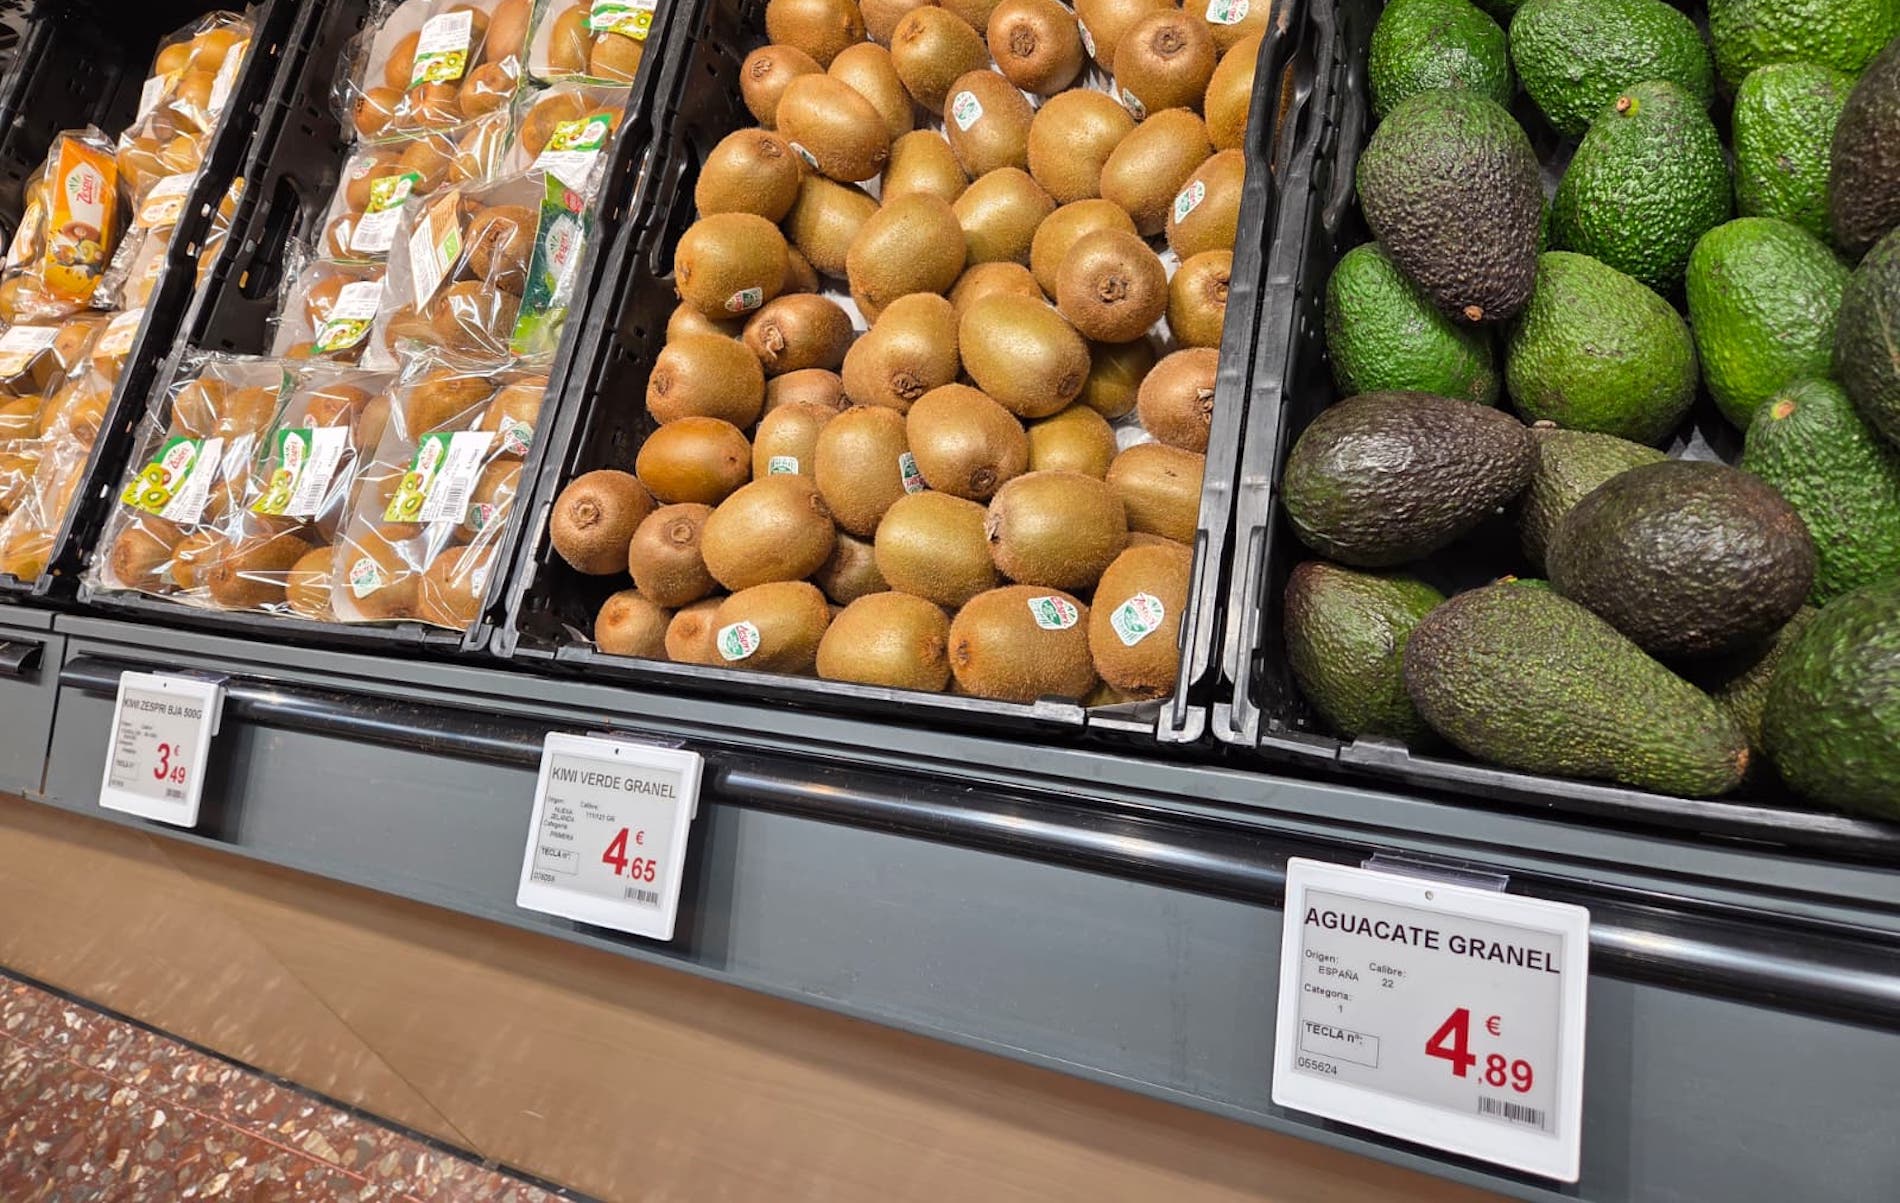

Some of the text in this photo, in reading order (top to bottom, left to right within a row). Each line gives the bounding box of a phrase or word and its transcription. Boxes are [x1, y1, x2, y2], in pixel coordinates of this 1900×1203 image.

[140, 700, 167, 714] ZESPRI
[167, 705, 183, 716] BJA
[183, 708, 203, 720] 500G
[154, 743, 170, 780] 3
[552, 767, 677, 799] KIWI VERDE GRANEL
[602, 828, 629, 875] 4
[636, 830, 645, 845] €
[1304, 907, 1561, 974] AGUACATE GRANEL
[1305, 949, 1339, 964] Origen:
[1318, 965, 1359, 981] ESPAÑA
[1369, 962, 1406, 978] Calibre:
[1381, 978, 1394, 988] 22
[1306, 1023, 1344, 1040] TECLA
[1425, 1008, 1476, 1078] 4
[1485, 1015, 1501, 1036] €
